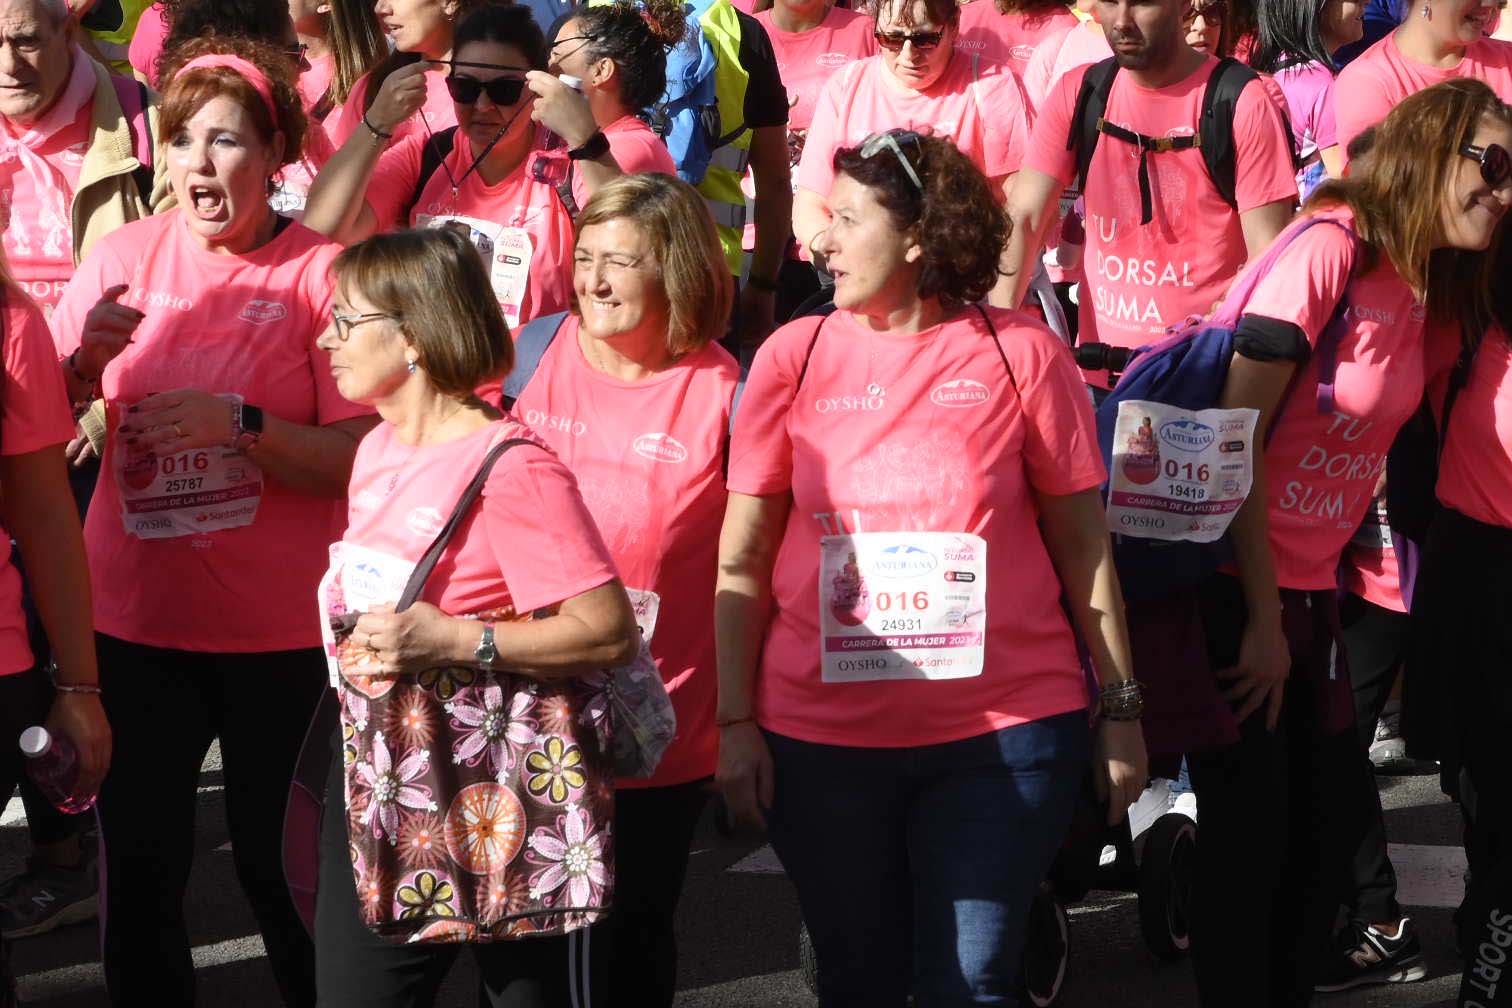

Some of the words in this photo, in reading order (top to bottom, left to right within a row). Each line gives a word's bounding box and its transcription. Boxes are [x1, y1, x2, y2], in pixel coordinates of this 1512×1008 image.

[1097, 248, 1195, 288] DORSAL
[135, 290, 194, 313] OYSHO
[1095, 286, 1163, 324] SUMA
[936, 390, 987, 402] ASTURIANA
[815, 395, 885, 414] OYSHO
[525, 408, 587, 437] OYSHO
[1327, 411, 1374, 442] TU
[162, 452, 209, 475] 016
[1164, 458, 1211, 482] 016
[165, 477, 204, 493] 25787
[1168, 484, 1206, 500] 19418
[169, 499, 182, 507] DE
[183, 496, 195, 505] LA
[1169, 502, 1181, 510] DE
[1183, 504, 1195, 512] LA
[1120, 514, 1166, 529] OYSHO
[943, 552, 975, 561] SUMA
[876, 591, 929, 612] 016
[881, 618, 922, 631] 24931
[842, 636, 883, 648] CARRERA
[886, 637, 901, 647] DE
[901, 637, 913, 646] LA
[914, 636, 946, 646] MUJER
[838, 658, 887, 672] OYSHO
